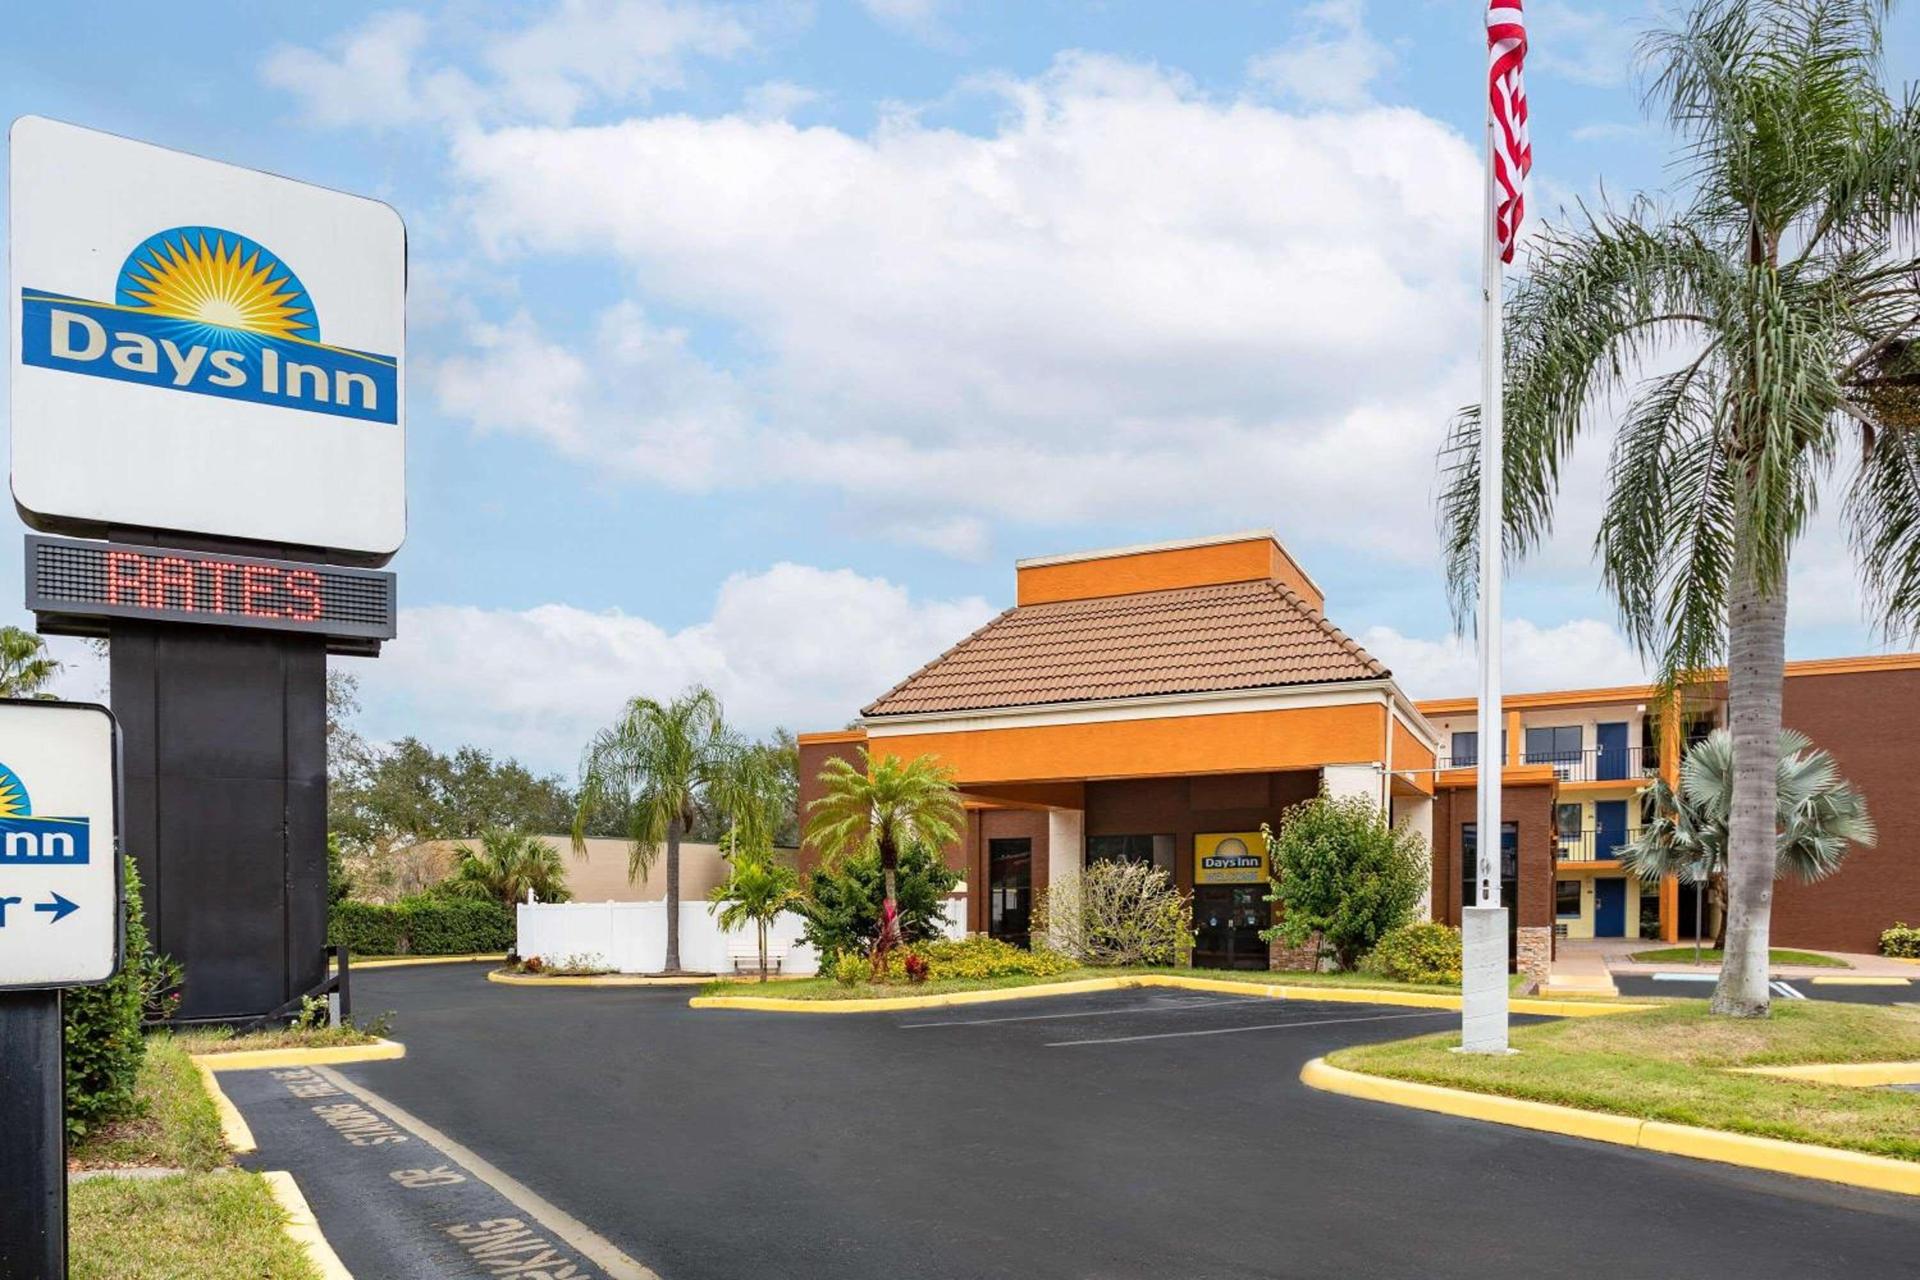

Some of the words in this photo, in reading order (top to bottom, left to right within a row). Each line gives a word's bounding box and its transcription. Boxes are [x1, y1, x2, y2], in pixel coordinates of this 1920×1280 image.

[51, 309, 247, 388] Days
[261, 347, 377, 410] Inn
[109, 551, 321, 622] RATES
[1205, 858, 1236, 868] Days
[1237, 857, 1259, 866] Inn
[389, 1165, 467, 1188] OR
